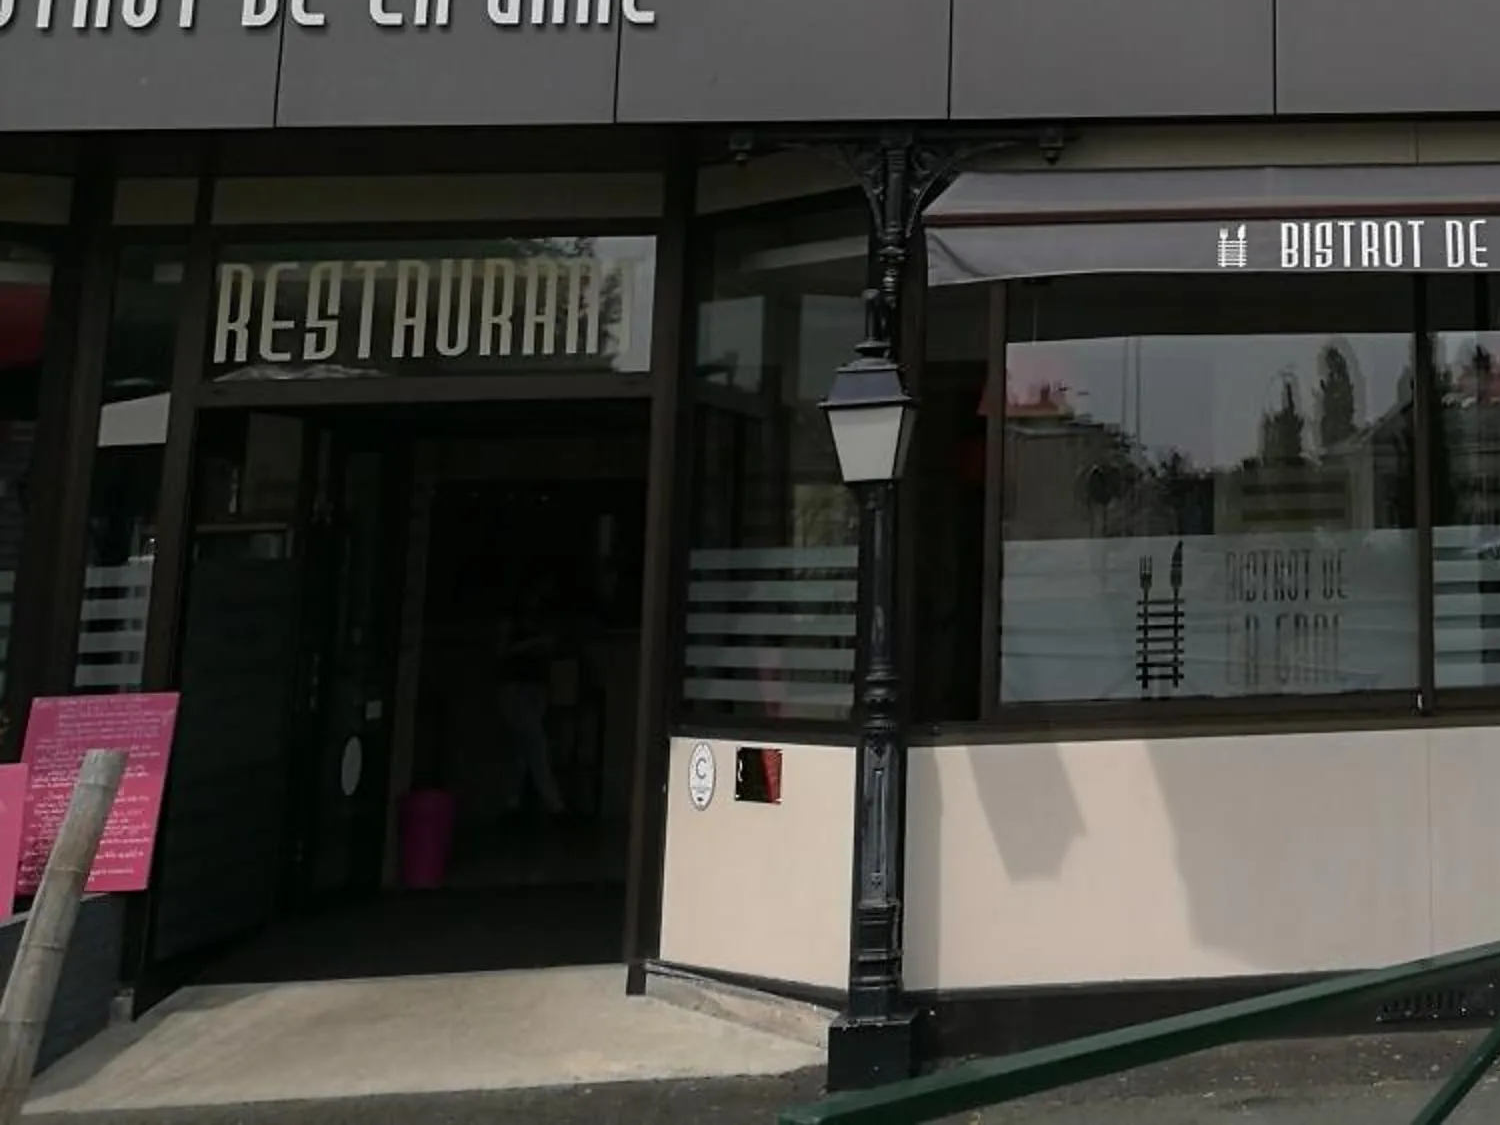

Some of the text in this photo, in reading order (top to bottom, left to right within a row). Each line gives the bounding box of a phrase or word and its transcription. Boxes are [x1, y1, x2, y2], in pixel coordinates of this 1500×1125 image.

[1280, 220, 1425, 269] BISTROT
[1445, 218, 1489, 268] DE
[213, 257, 644, 364] RESTAURANT
